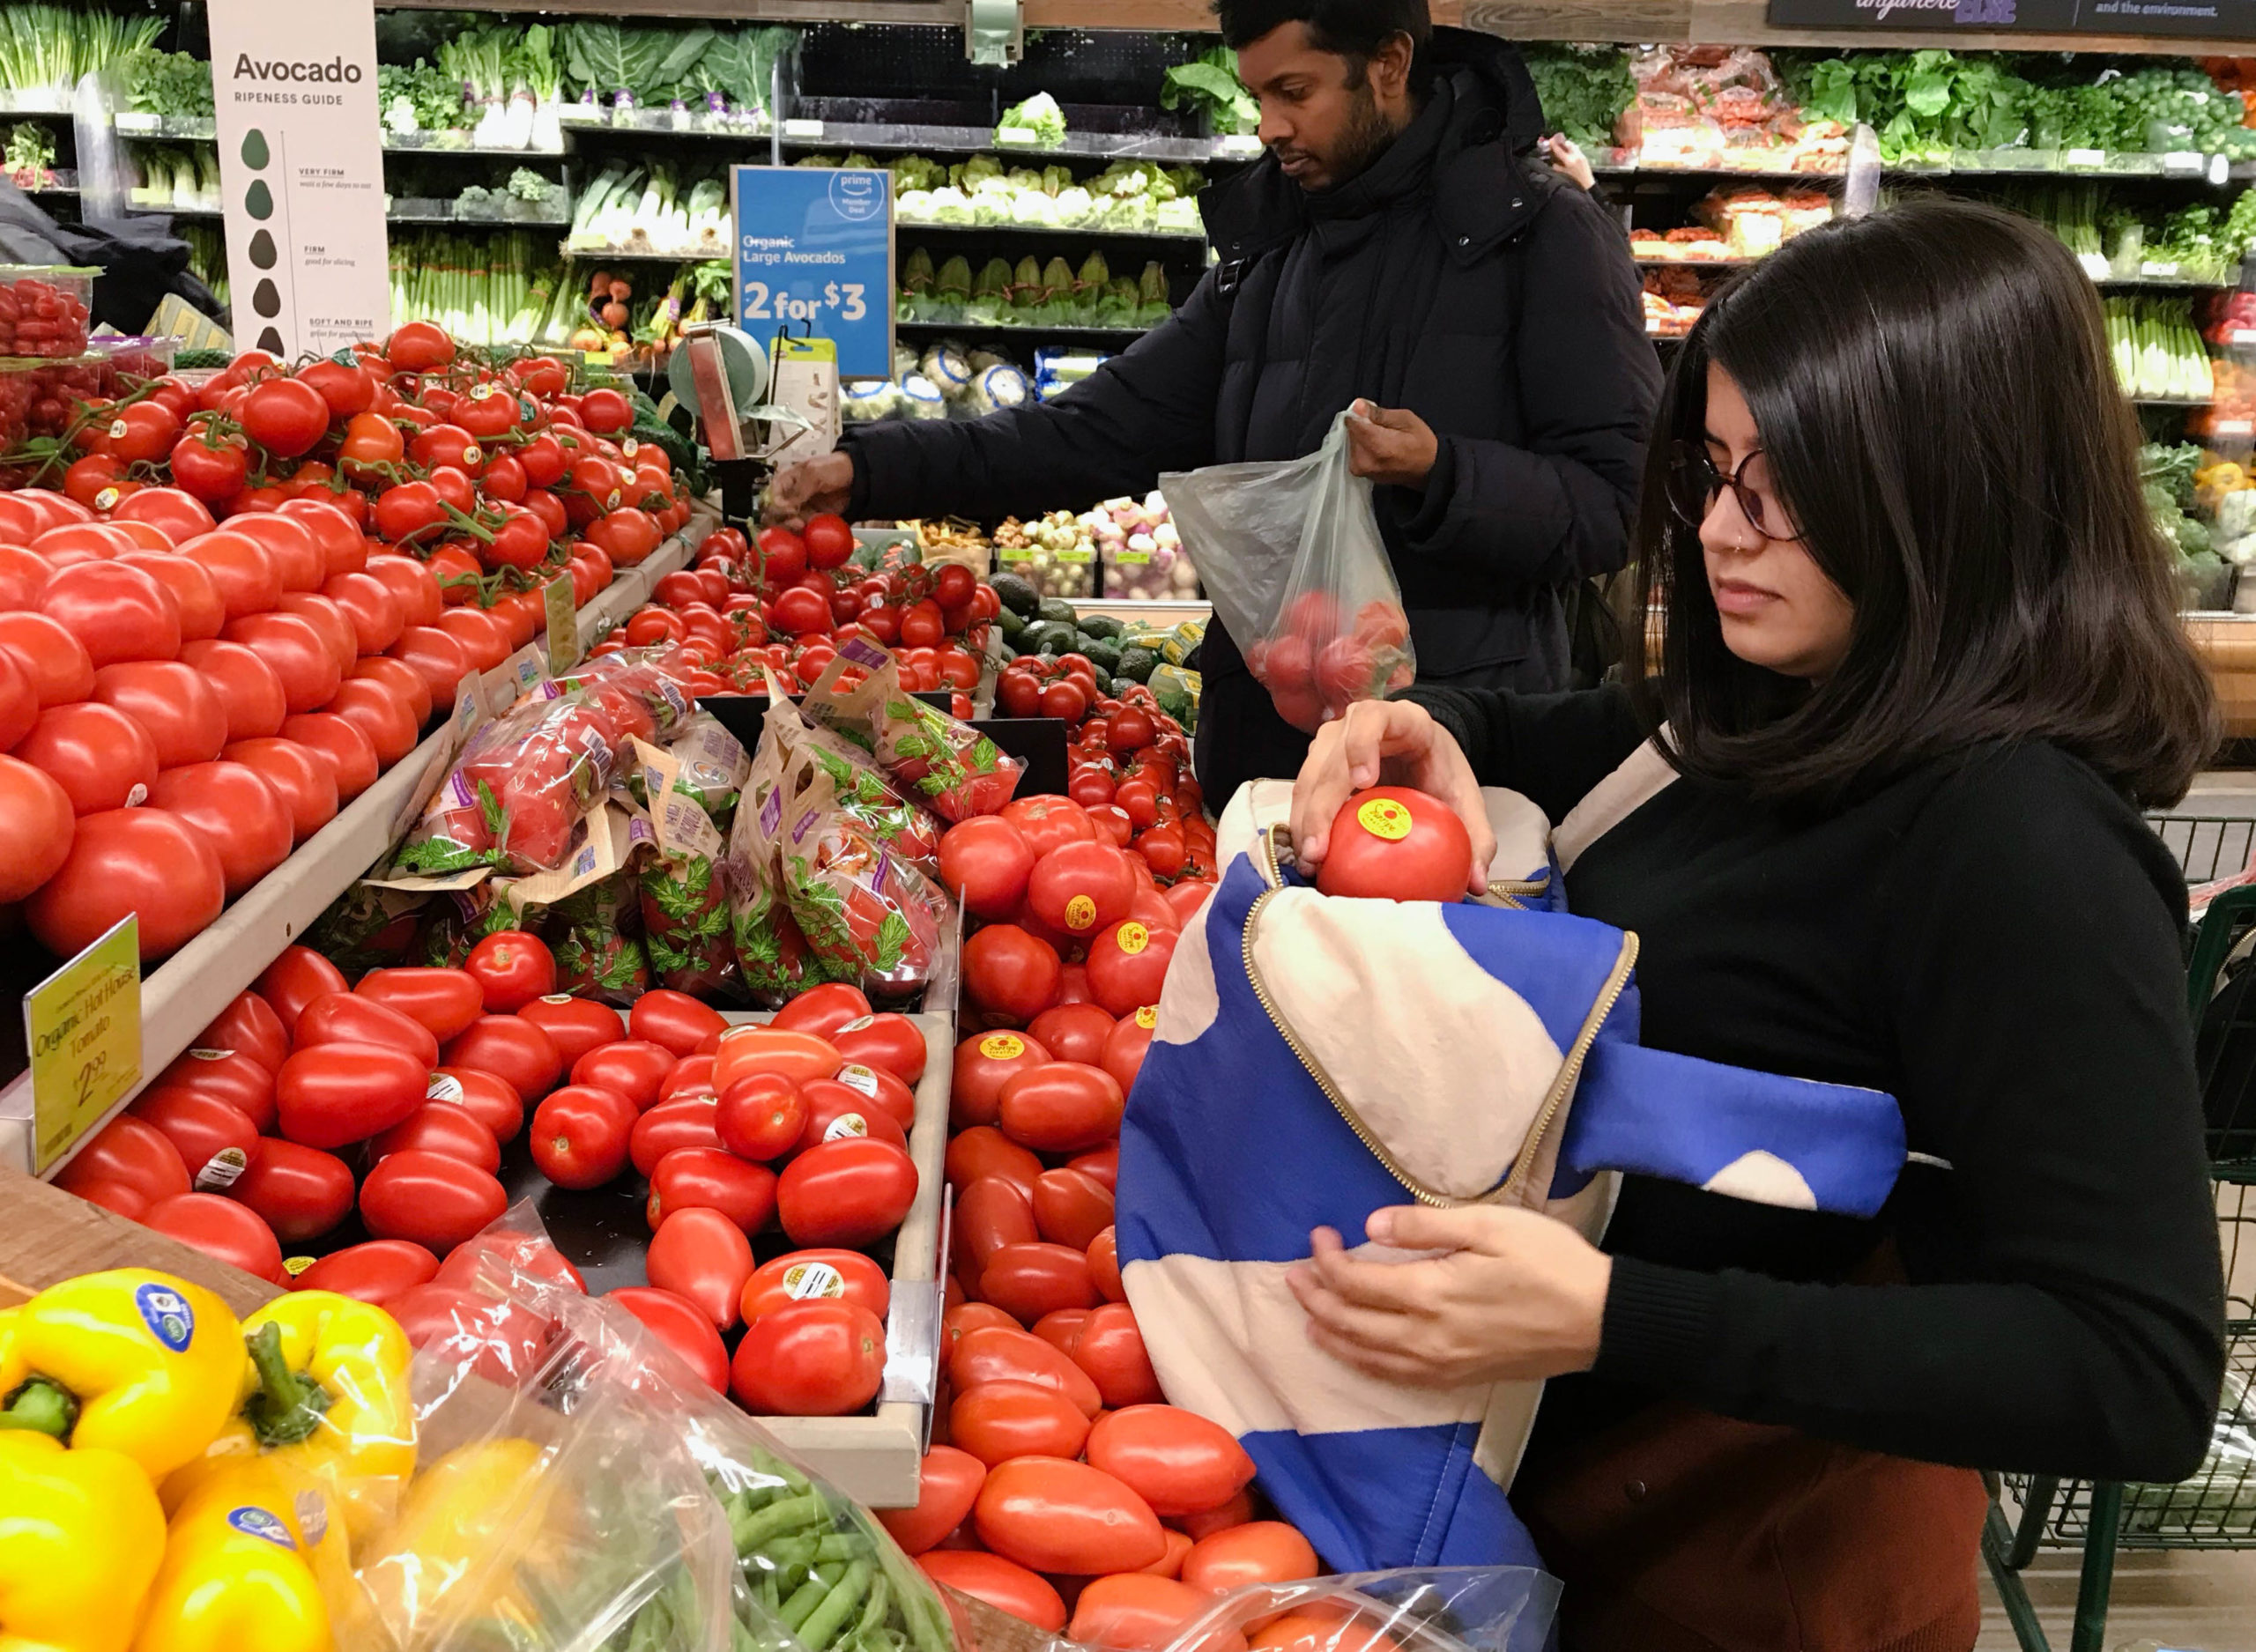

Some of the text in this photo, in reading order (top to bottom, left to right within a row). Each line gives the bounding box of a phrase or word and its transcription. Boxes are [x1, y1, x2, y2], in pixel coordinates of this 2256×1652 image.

[2096, 1, 2219, 18] and the environment.
[234, 53, 362, 84] Avocado
[234, 92, 343, 106] RIPENESS GUIDE
[841, 174, 872, 187] prime
[743, 235, 795, 250] Organic
[743, 250, 846, 266] Large Avocados
[744, 280, 867, 322] 2 for $3
[36, 1010, 82, 1057] Organic
[70, 1016, 110, 1058] Tomato
